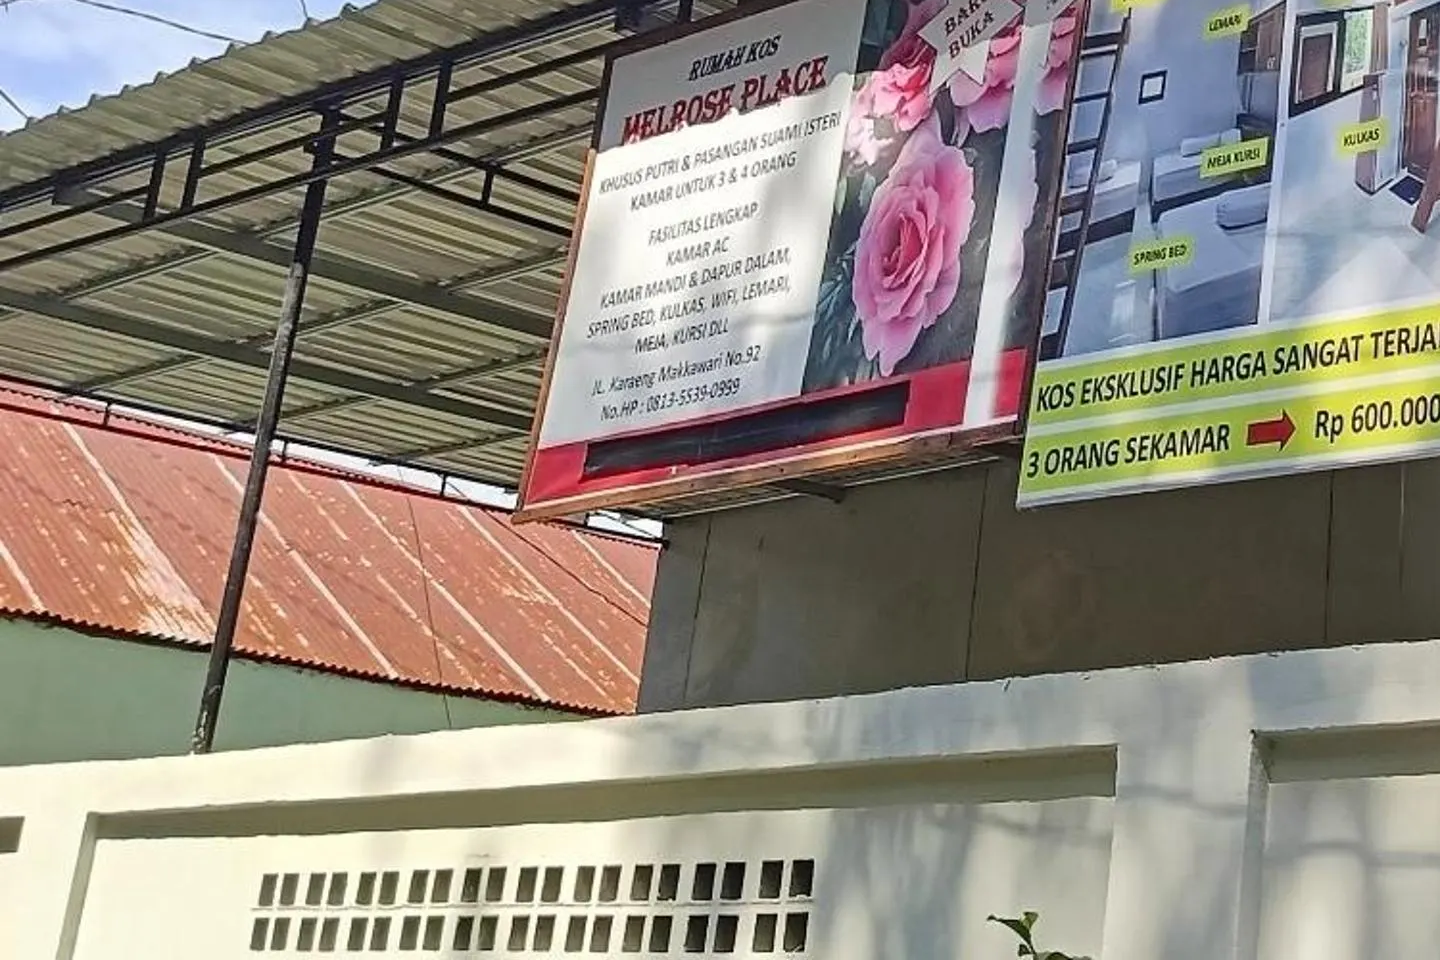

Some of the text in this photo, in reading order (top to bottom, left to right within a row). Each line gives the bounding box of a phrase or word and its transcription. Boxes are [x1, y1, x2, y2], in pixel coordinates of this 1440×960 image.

[949, 11, 994, 59] BUKA
[688, 35, 782, 82] RUMAH KOS
[621, 55, 830, 146] MELROSE PLACE
[599, 111, 842, 194] KHUSUS PUTRI & PASANGAN SUAMI ISTERI
[1207, 147, 1260, 169] MEJA KURSI
[1343, 128, 1380, 147] KULKAS
[630, 151, 797, 212] KAMAR UNTUK 3 & 4 ORANG
[648, 202, 759, 246] FASILITAS LENGKAP
[666, 236, 730, 267] KAMAR AC
[1134, 244, 1187, 266] SPRING BED
[600, 286, 642, 310] KAMAR
[644, 276, 687, 301] MANDI
[688, 272, 698, 288] &
[701, 260, 742, 285] DAPUR
[587, 312, 629, 339] SPRING
[671, 324, 709, 346] KURSI
[709, 318, 729, 337] DLL
[609, 369, 656, 393] Karaeng
[658, 352, 723, 383] Makkawari
[1036, 381, 1076, 412] KOS
[1080, 361, 1186, 406] EKSKLUSIF
[1190, 351, 1266, 387] HARGA
[1273, 334, 1364, 375] SANGAT
[646, 378, 741, 414] 0813-5539-0999
[1026, 451, 1039, 478] 3
[1044, 439, 1119, 476] ORANG
[1125, 424, 1230, 464] SEKAMAR
[1315, 410, 1344, 443] Rp
